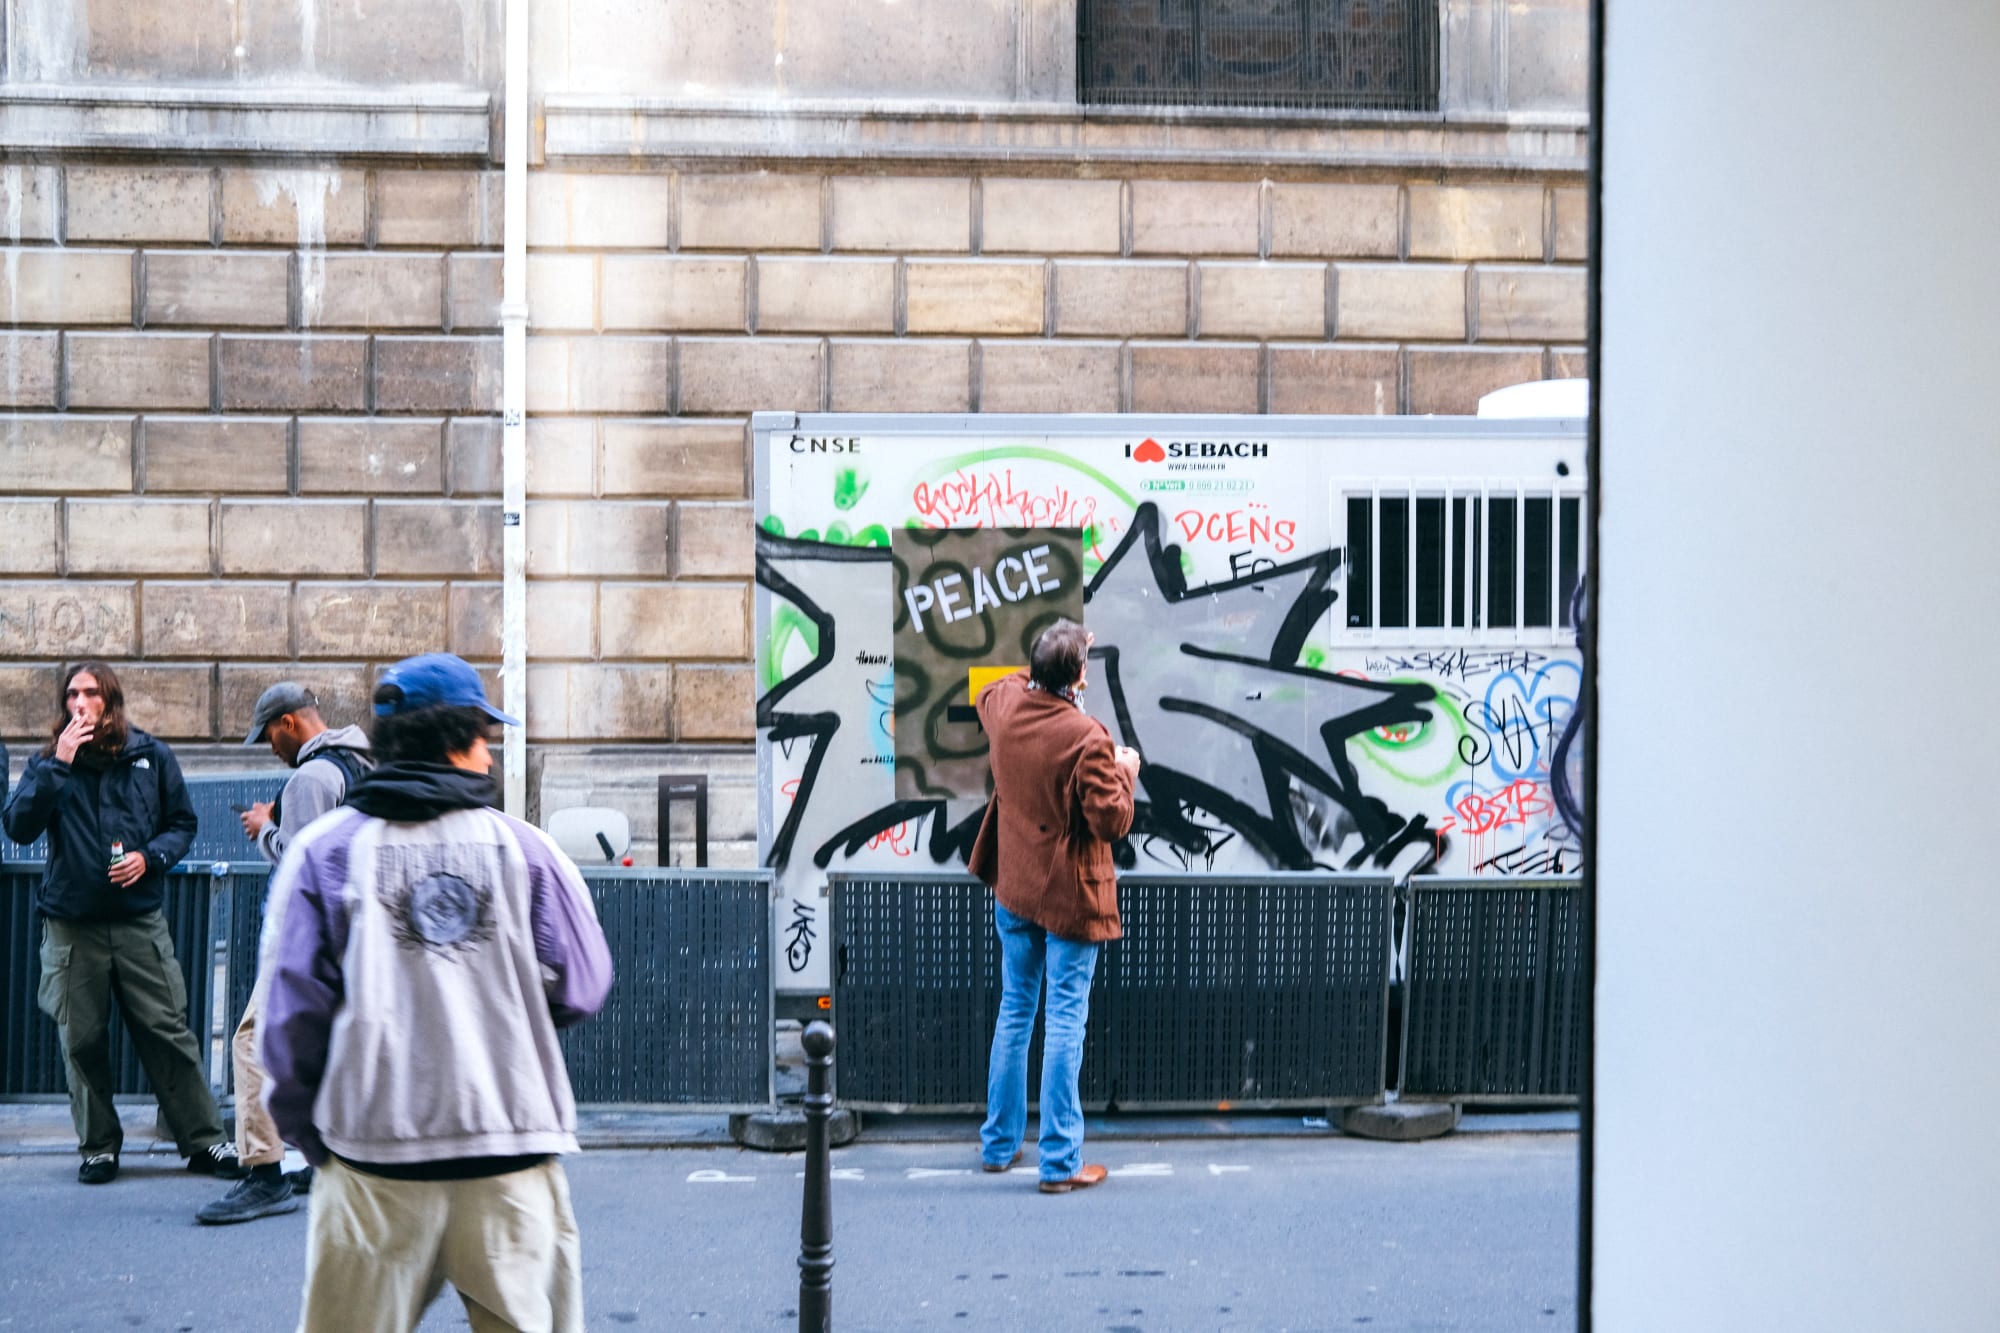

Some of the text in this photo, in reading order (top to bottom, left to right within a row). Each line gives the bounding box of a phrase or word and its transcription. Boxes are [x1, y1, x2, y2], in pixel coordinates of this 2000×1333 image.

[790, 437, 860, 453] CNSE
[1168, 442, 1268, 458] SEBACH
[904, 544, 1061, 633] PEACE
